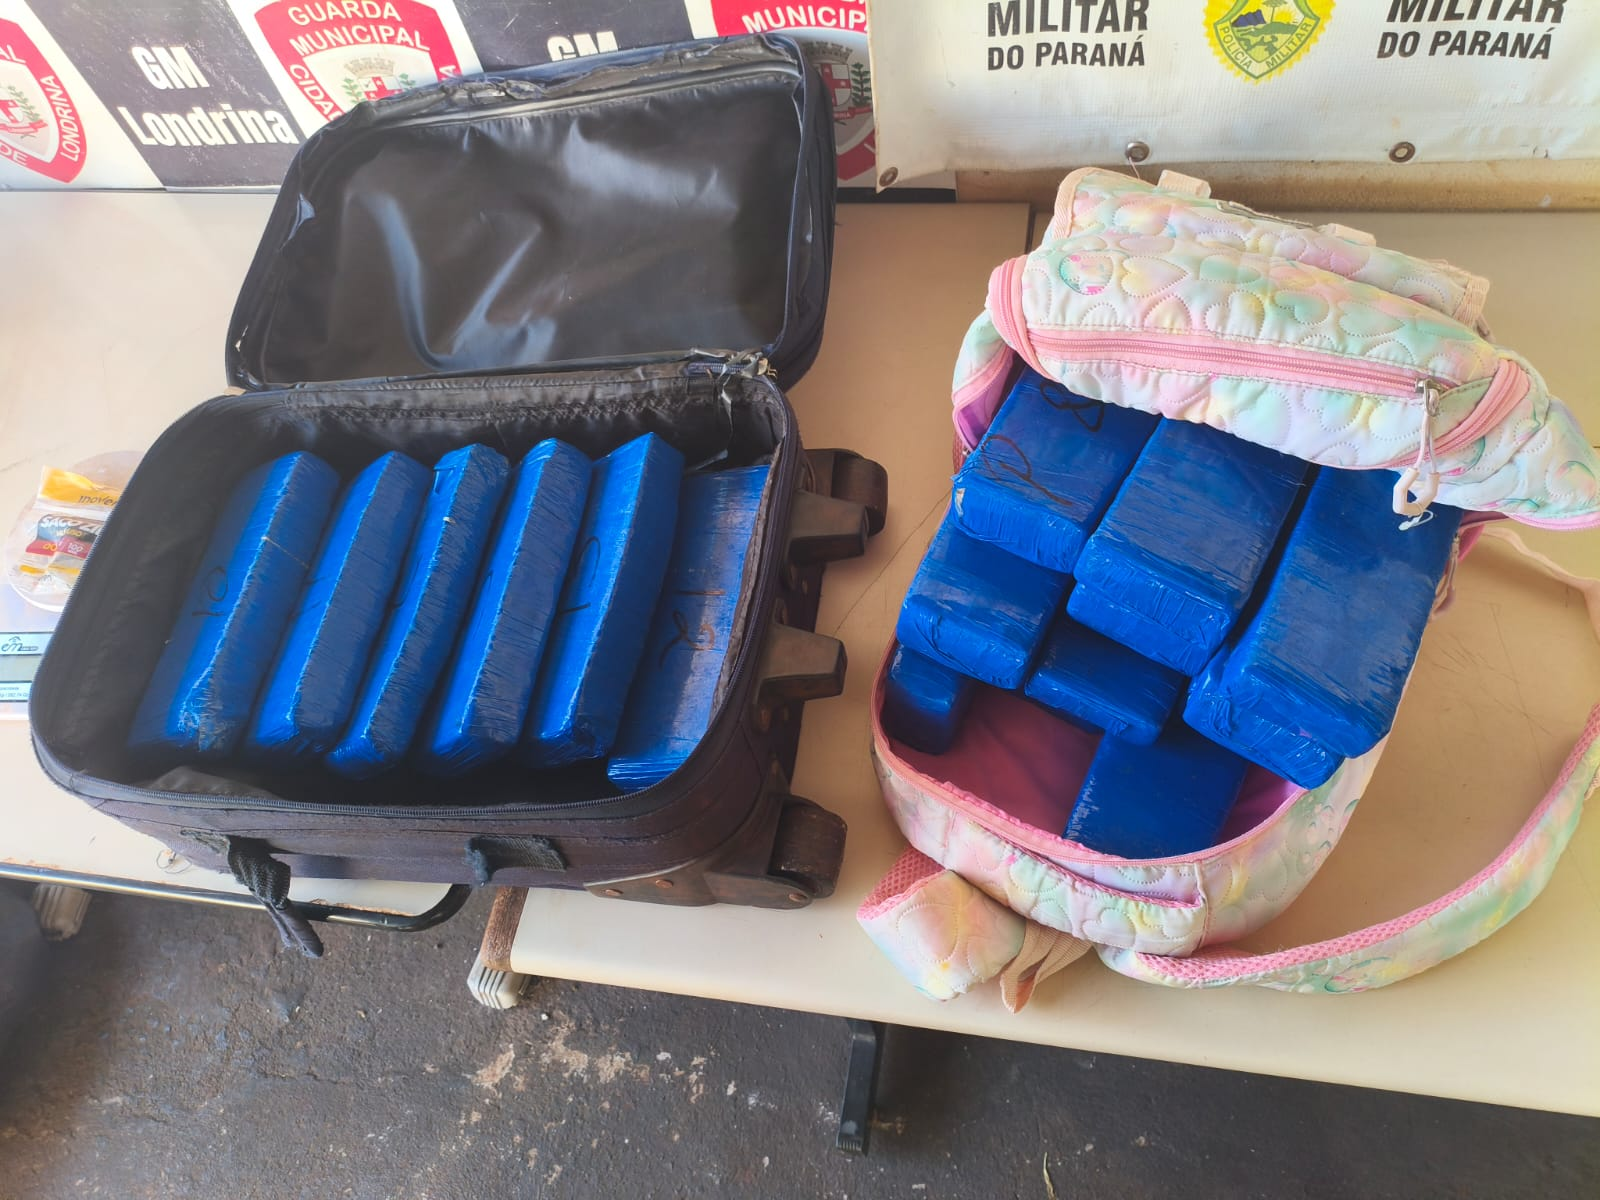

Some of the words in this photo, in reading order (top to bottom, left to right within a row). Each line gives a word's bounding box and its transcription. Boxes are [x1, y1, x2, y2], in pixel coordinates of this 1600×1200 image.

[288, 0, 401, 26] GUARDA
[742, 5, 868, 34] MUNICIP
[988, 0, 1149, 37] MILITAR
[1386, 0, 1568, 23] MILITAR
[289, 25, 430, 57] MUNICIPAL
[988, 45, 1024, 70] DO
[1036, 34, 1145, 67] PARANÁ
[1266, 22, 1313, 69] MILITAR
[1377, 31, 1420, 58] DO
[1428, 27, 1556, 60] PARANÁ
[132, 46, 209, 90] GM
[40, 75, 81, 161] LONDRINA
[118, 103, 299, 147] Londrina
